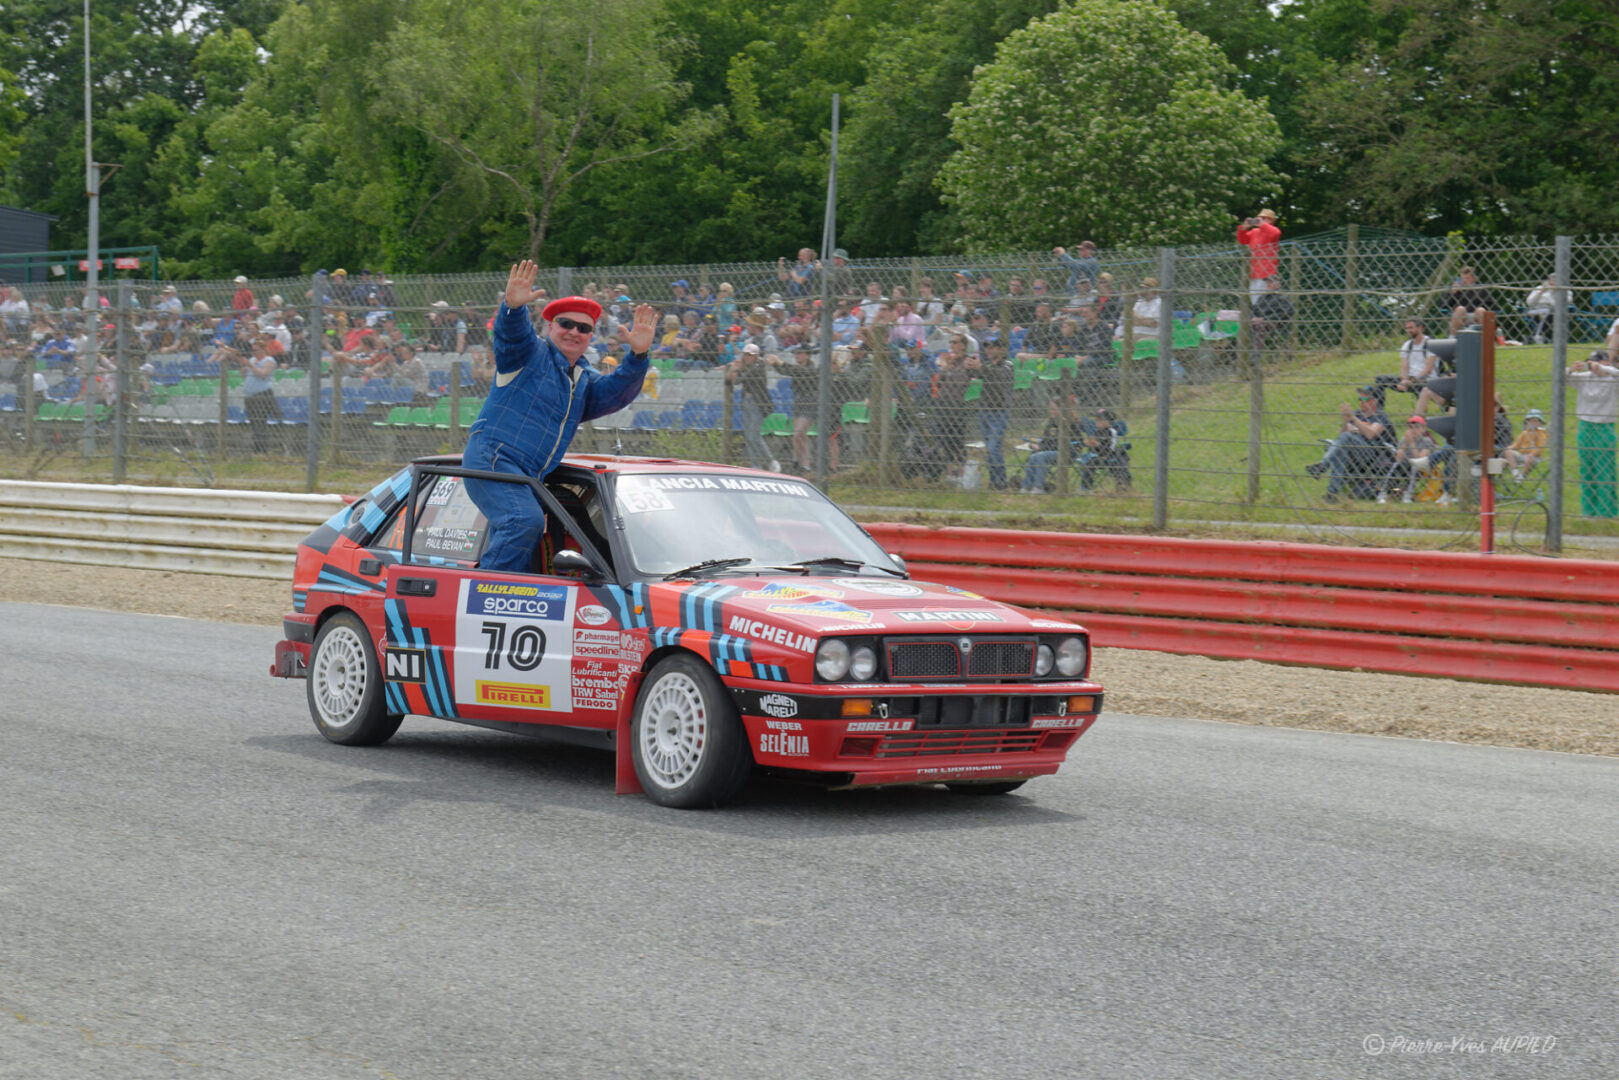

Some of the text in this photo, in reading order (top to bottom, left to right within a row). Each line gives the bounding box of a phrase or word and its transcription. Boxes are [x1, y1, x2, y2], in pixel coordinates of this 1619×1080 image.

[431, 482, 456, 498] 569
[719, 479, 809, 497] MARTINI
[427, 527, 443, 538] PAUL
[425, 538, 464, 551] PAUL BEVAN
[484, 597, 548, 615] sparco
[900, 611, 999, 622] MARTINI
[821, 622, 886, 632] MICHELIN
[729, 615, 818, 653] MICHELIN
[481, 621, 547, 671] 70
[575, 645, 619, 656] speedline
[387, 652, 420, 678] NI
[587, 661, 602, 669] Fiat
[572, 667, 618, 677] Lubrificanti
[481, 684, 544, 704] PIRELLI
[572, 687, 594, 698] TRW
[575, 699, 613, 708] FERODO
[765, 720, 803, 731] WEBER
[847, 721, 913, 732] CARELLO
[1031, 718, 1086, 729] CARELLO
